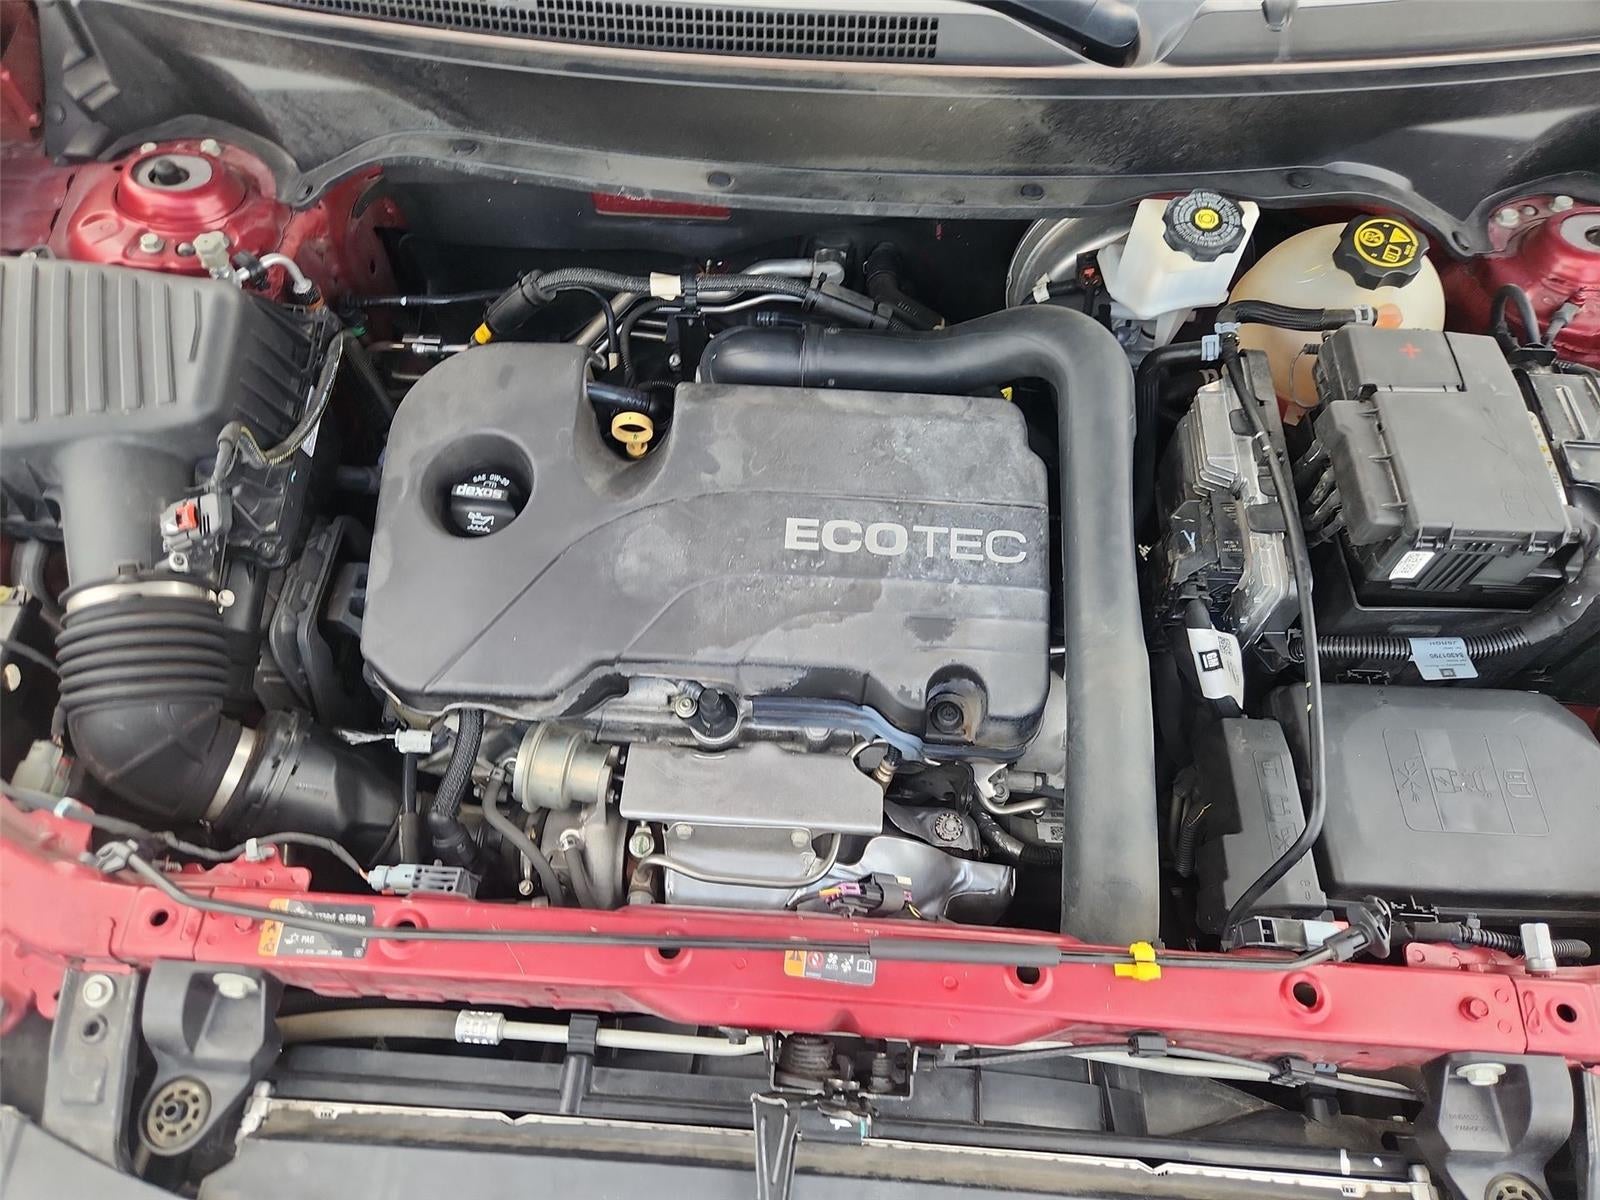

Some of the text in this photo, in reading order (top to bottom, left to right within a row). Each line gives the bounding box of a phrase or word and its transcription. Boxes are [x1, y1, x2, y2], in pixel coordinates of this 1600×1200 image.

[456, 483, 503, 499] dexos
[784, 517, 1027, 564] ECOTEC
[301, 935, 315, 945] PAG
